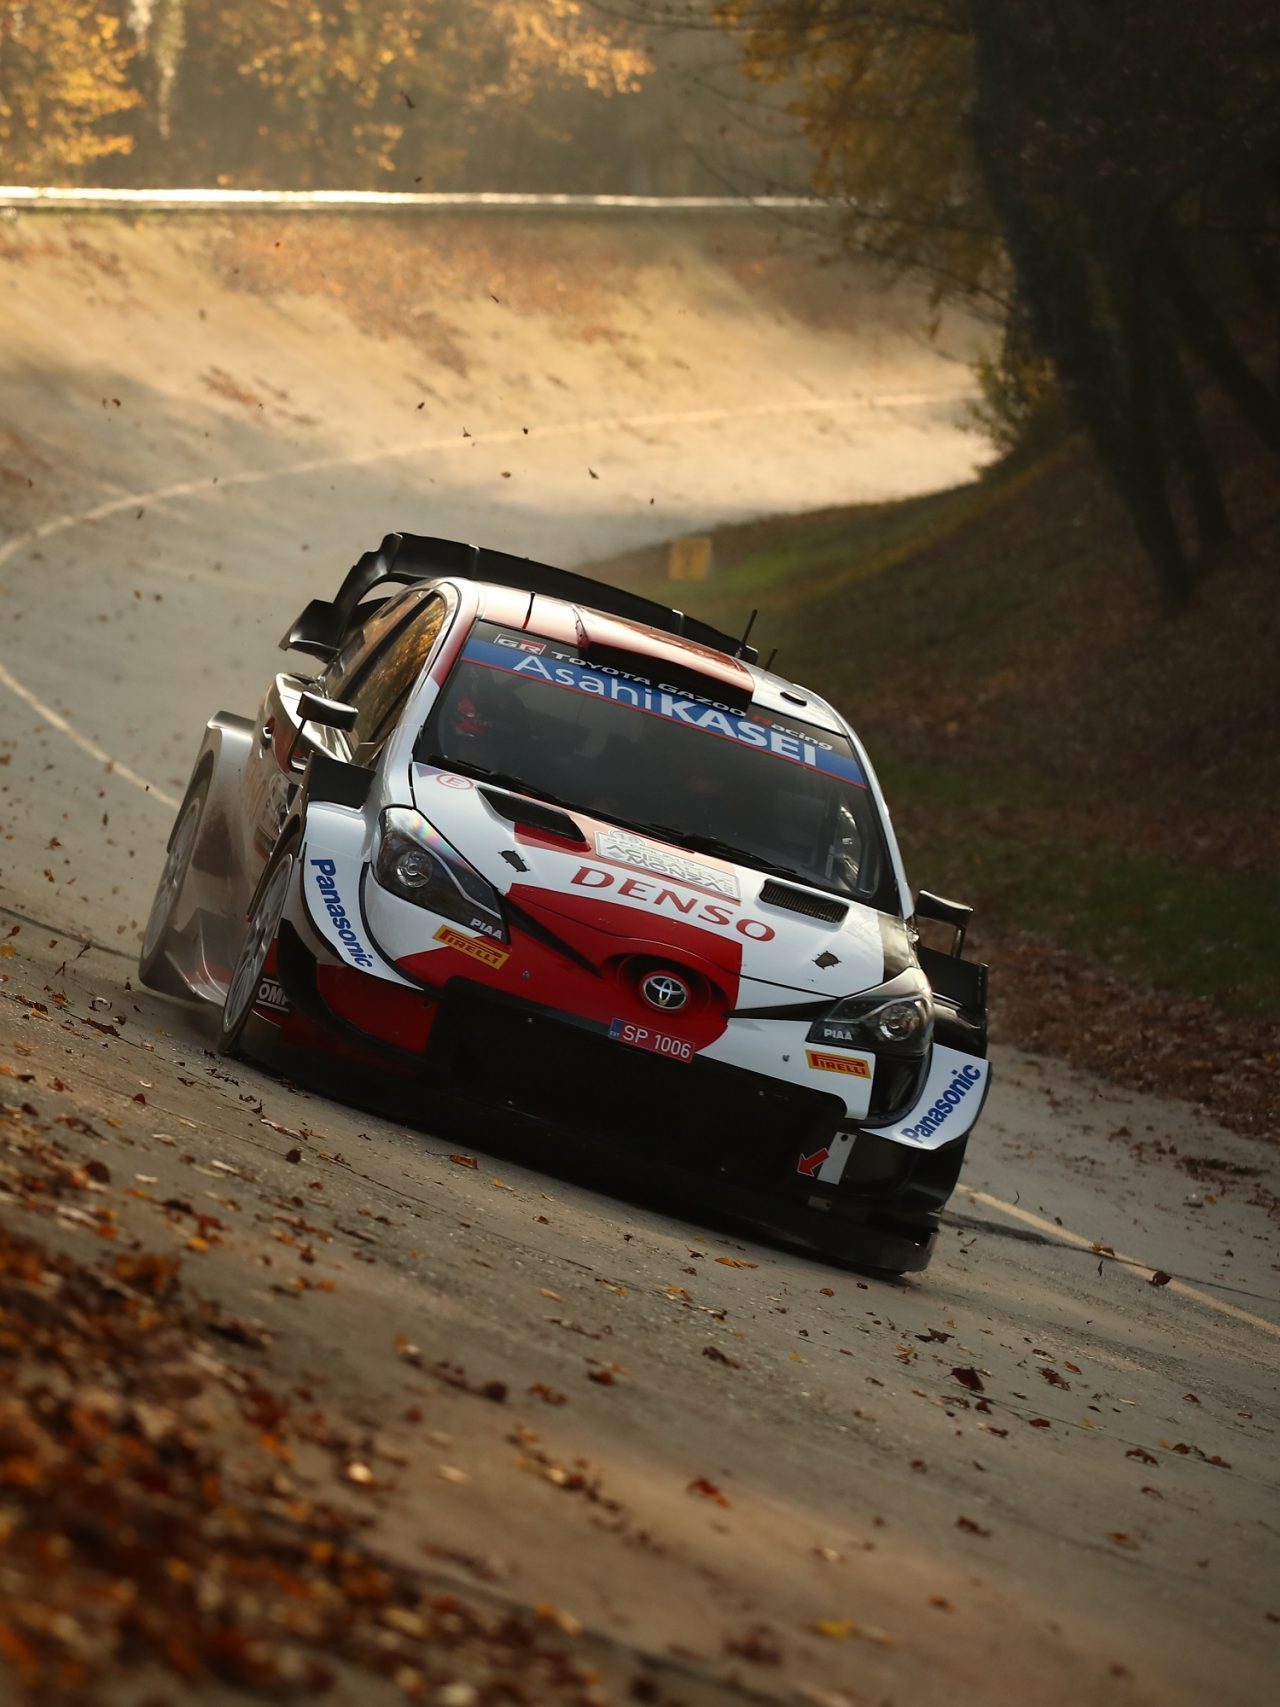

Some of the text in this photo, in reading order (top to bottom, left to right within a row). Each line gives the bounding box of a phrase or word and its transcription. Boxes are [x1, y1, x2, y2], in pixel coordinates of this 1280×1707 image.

[496, 635, 833, 751] GR TOYOTA GAZOO Racing
[310, 858, 373, 968] Panasonic
[570, 865, 776, 942] DENSO
[439, 928, 501, 966] PIRELLI
[470, 917, 504, 940] PIAA
[622, 1025, 692, 1059] SP 1006
[823, 1028, 854, 1041] PIAA
[811, 1053, 867, 1075] PIRELLI
[900, 1064, 981, 1144] Panasonic
